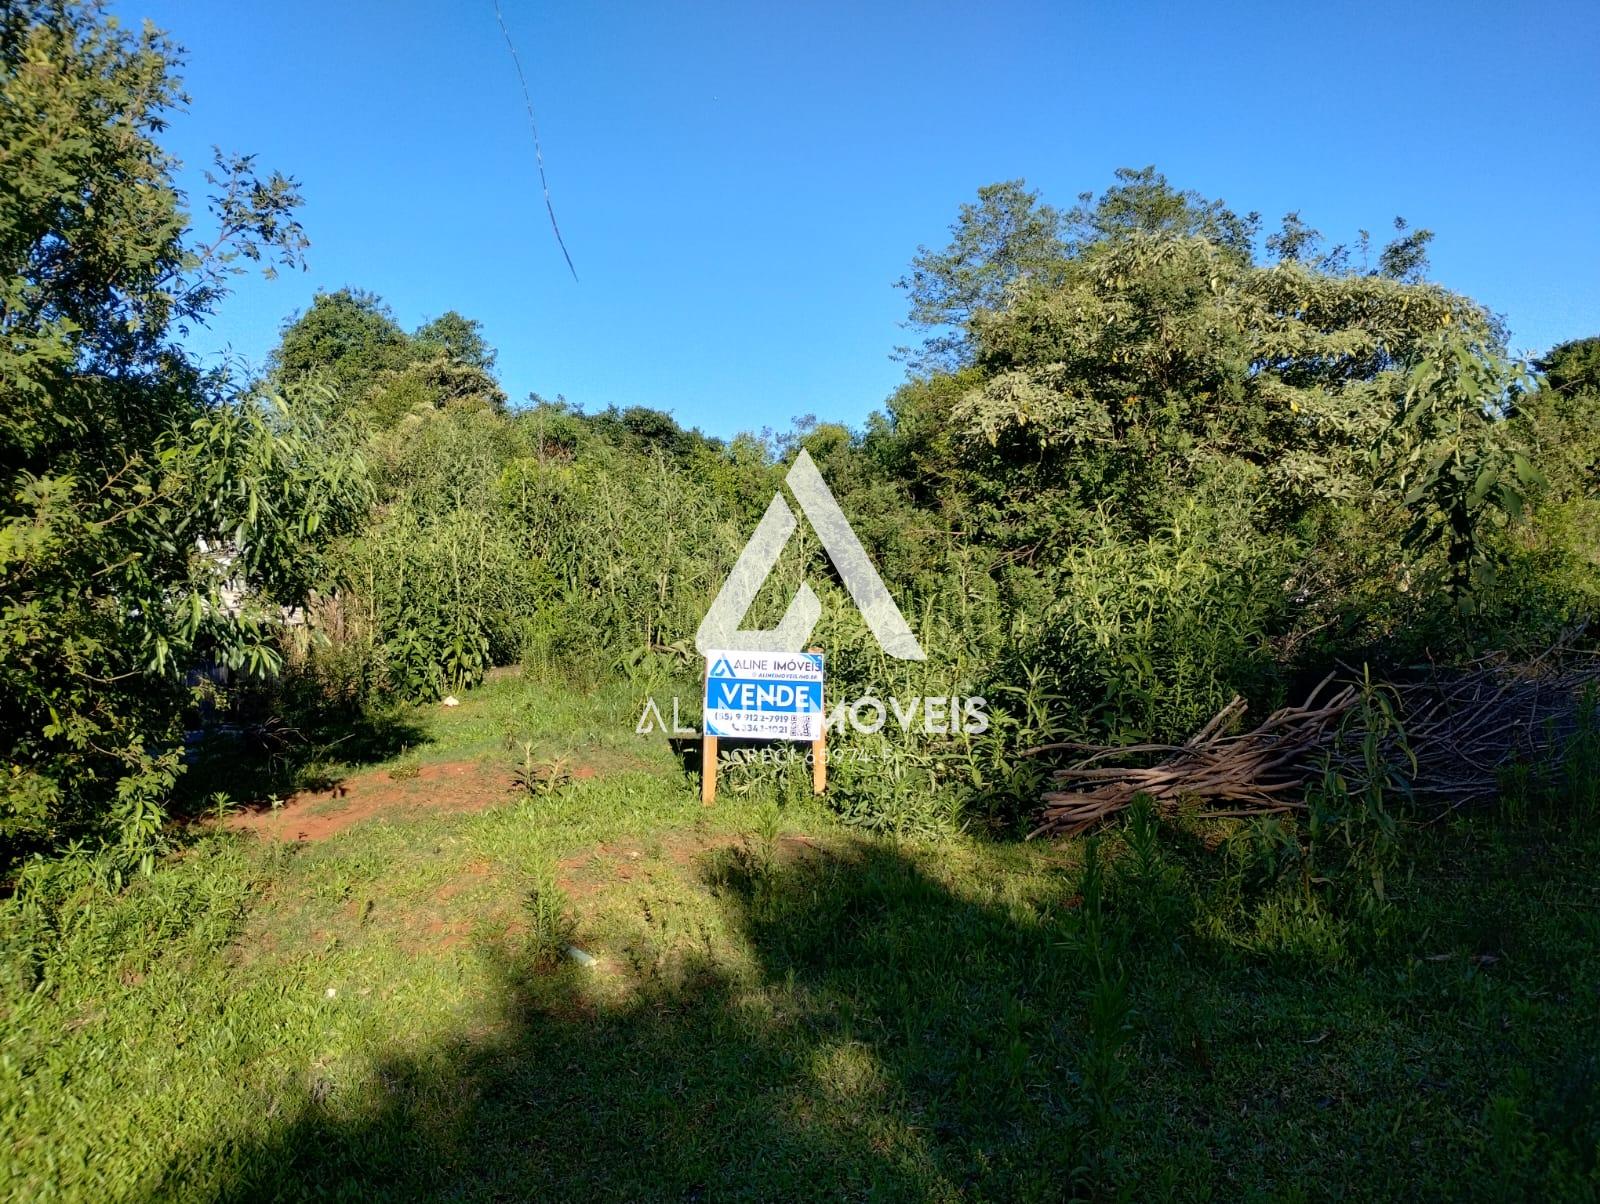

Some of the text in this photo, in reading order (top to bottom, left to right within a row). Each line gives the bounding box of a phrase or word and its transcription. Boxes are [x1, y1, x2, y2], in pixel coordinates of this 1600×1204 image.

[734, 659, 821, 672] ALINE IMÓVEIS
[720, 682, 810, 708] VENDE
